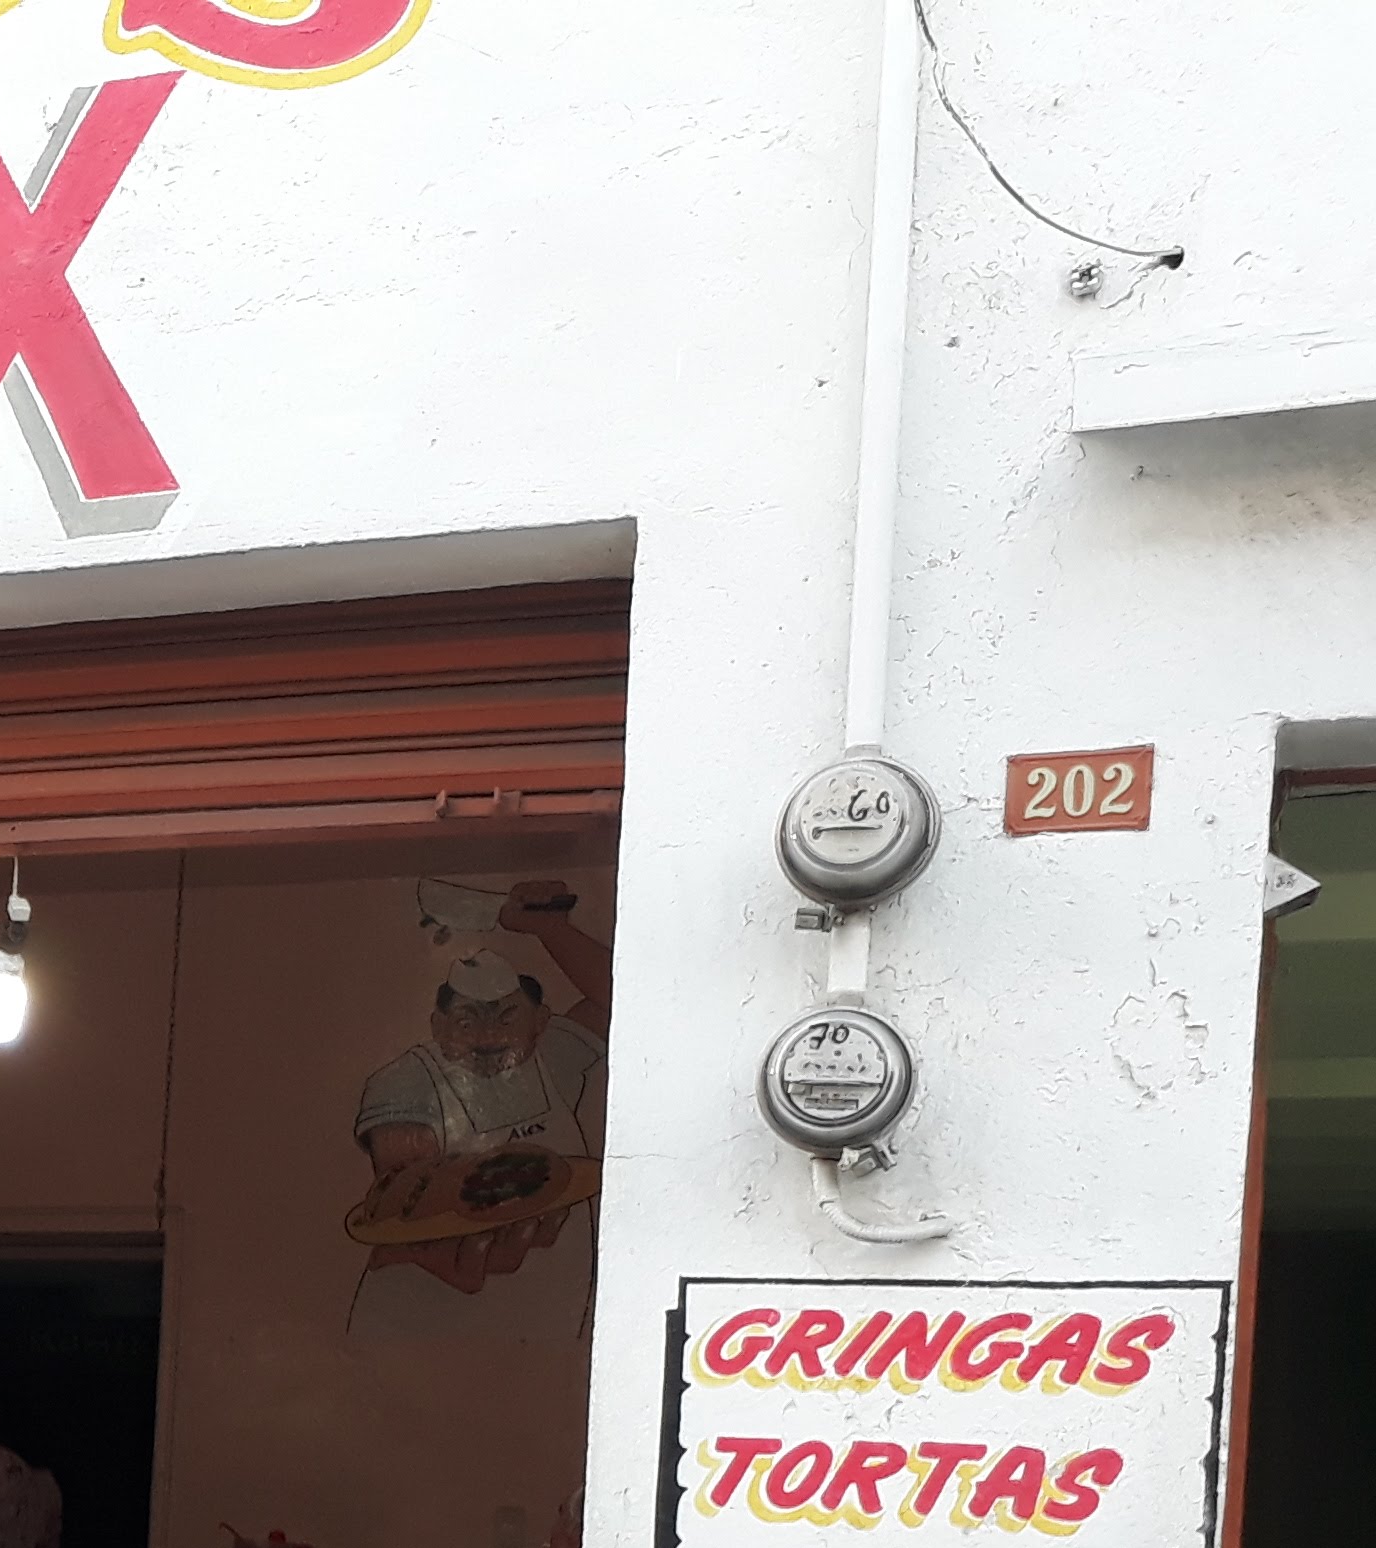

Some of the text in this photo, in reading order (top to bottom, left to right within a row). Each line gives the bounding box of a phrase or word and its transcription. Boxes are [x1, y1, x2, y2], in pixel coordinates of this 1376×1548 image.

[1022, 762, 1136, 820] 202
[689, 1308, 1176, 1395] GRINGAS
[693, 1436, 1124, 1535] TORTAS
